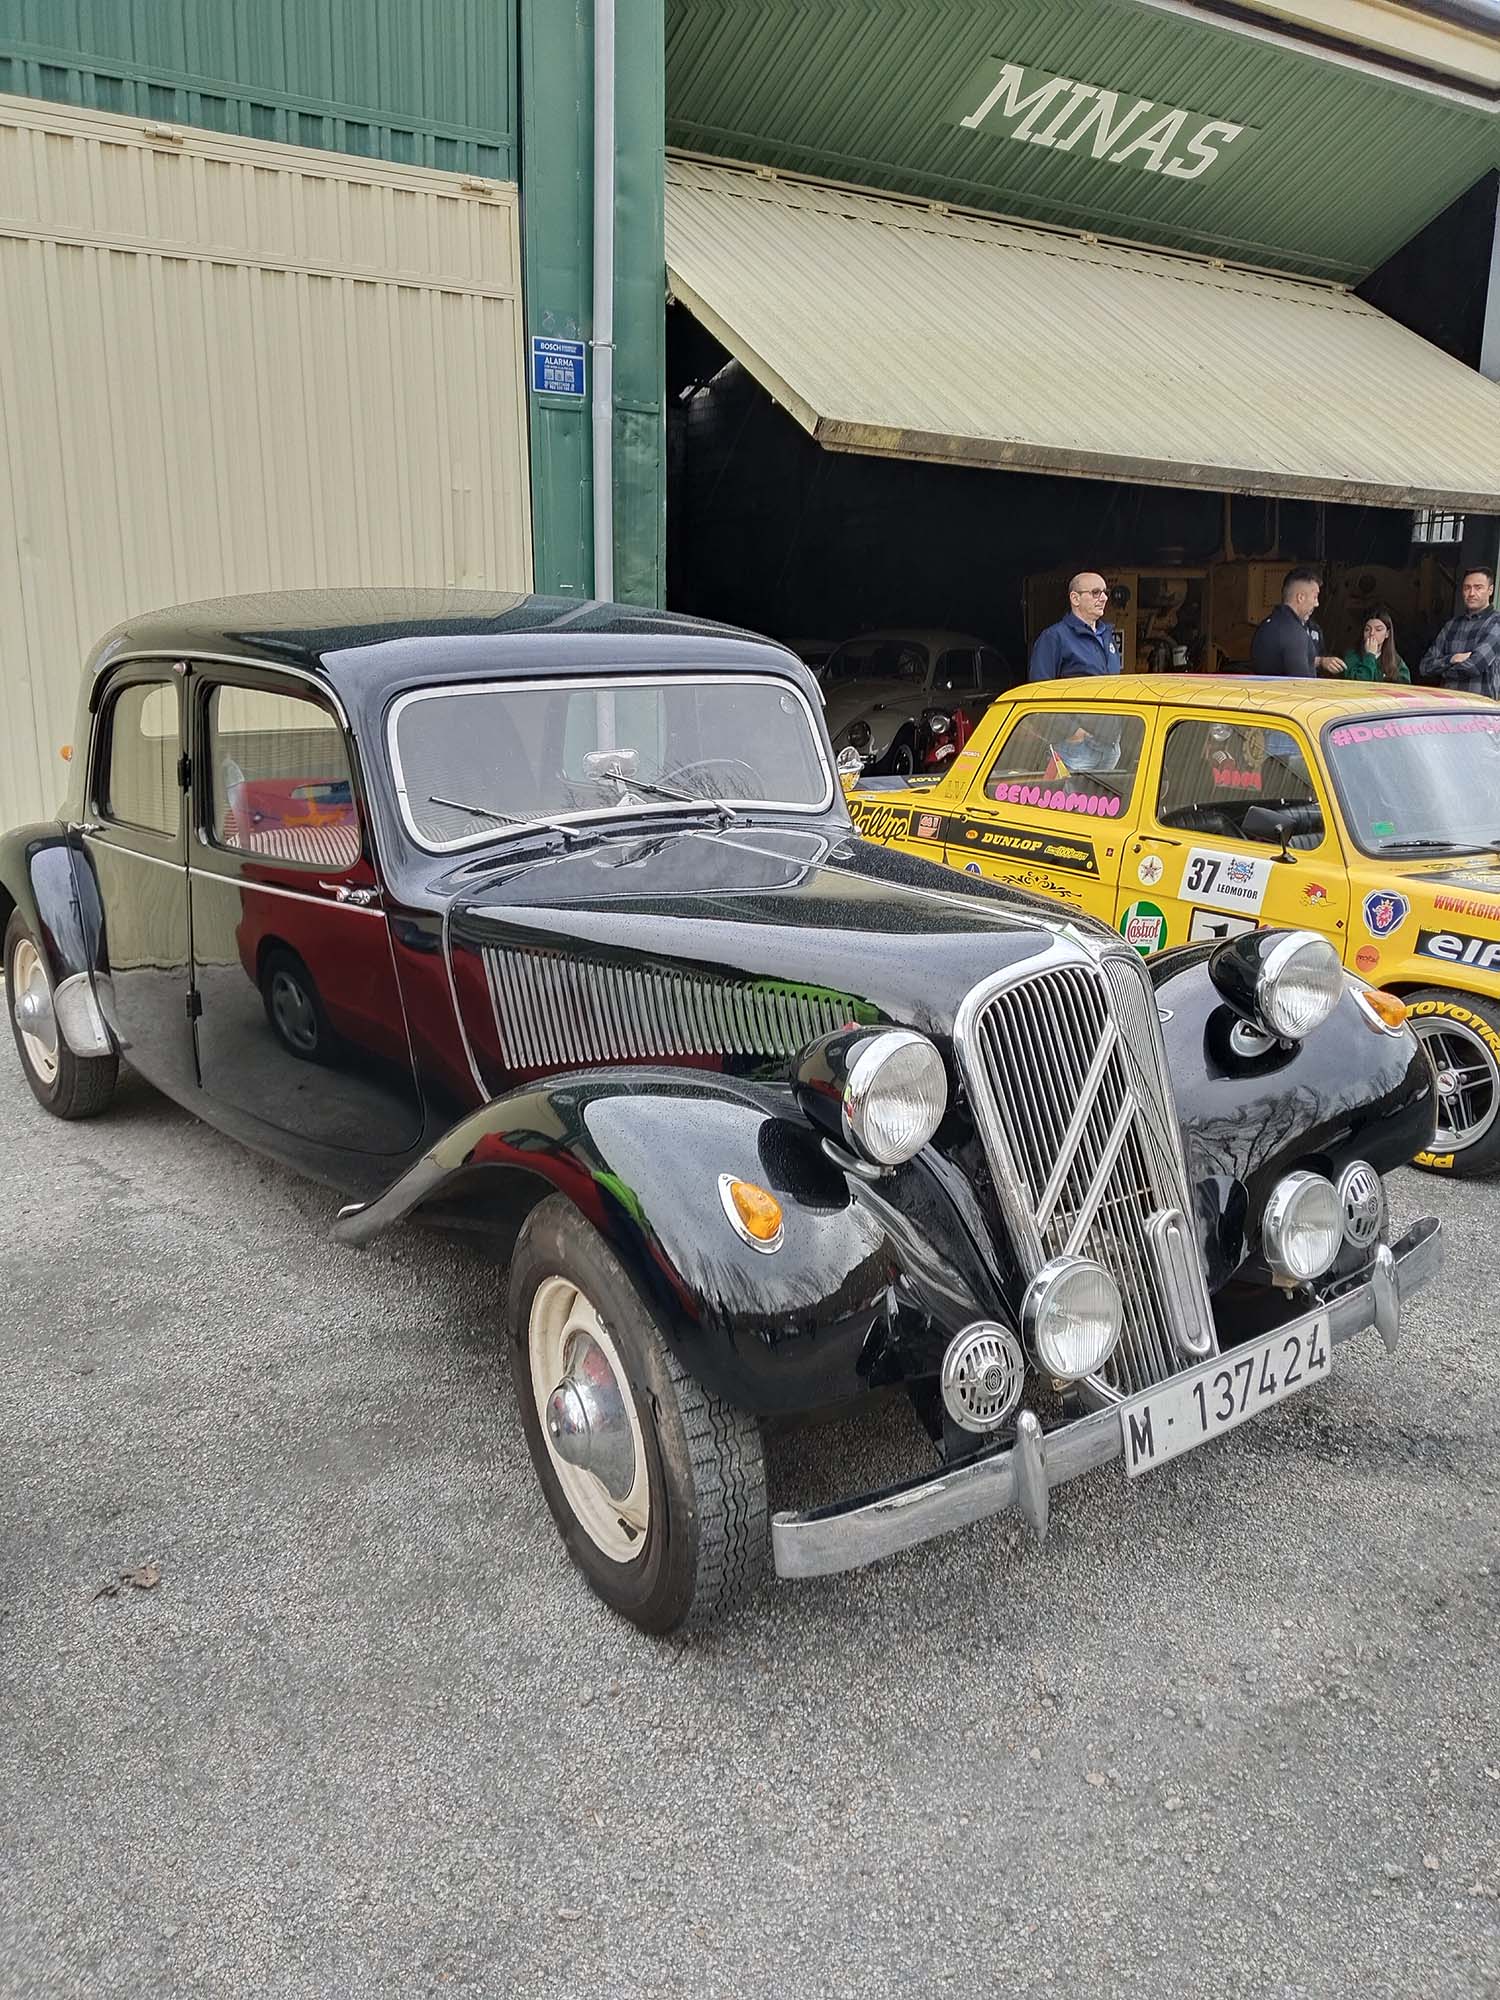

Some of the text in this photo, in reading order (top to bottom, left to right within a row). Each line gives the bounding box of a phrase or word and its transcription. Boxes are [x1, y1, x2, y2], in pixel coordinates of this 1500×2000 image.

[960, 64, 1244, 179] MINAS
[540, 342, 562, 352] BOSCH
[544, 356, 574, 367] ALARMA
[994, 783, 1120, 817] BENJAMIN
[981, 832, 1043, 851] DUNLOP
[1187, 857, 1222, 894] 37
[1216, 883, 1258, 900] LEOMOTOR
[1127, 918, 1161, 944] Castrol
[1428, 935, 1500, 967] elf
